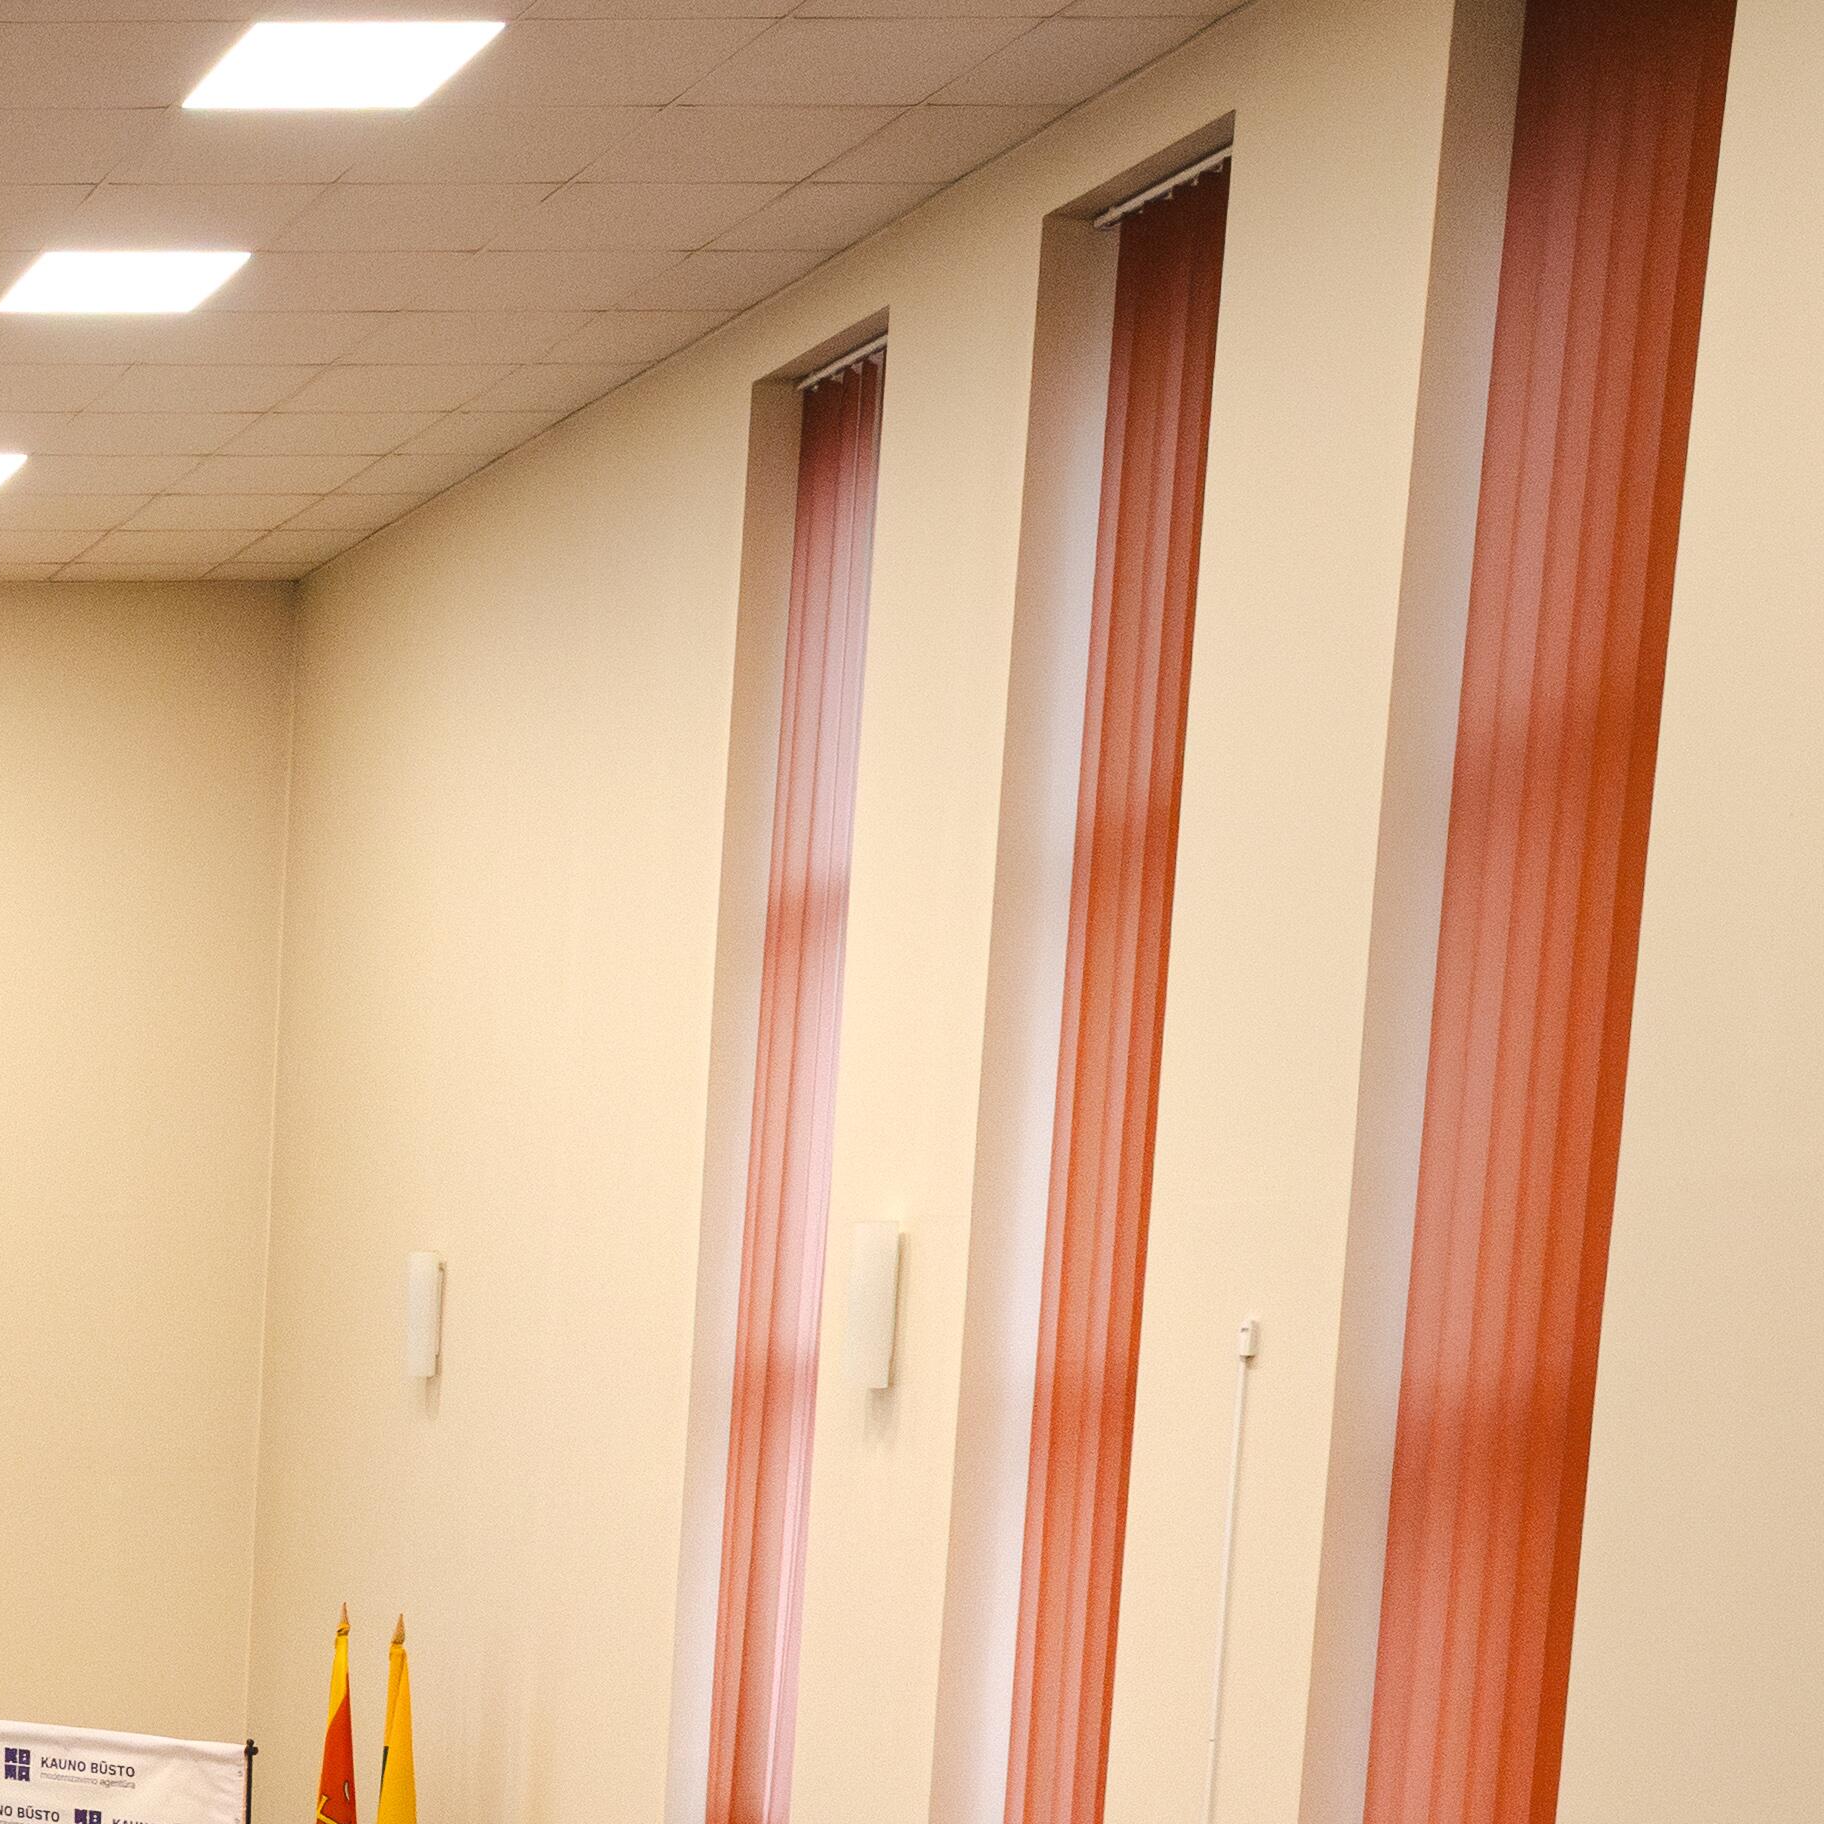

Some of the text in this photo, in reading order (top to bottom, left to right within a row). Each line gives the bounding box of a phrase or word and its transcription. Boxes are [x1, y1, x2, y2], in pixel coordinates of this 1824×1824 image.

[41, 1757, 135, 1777] KAUNO BŪSTO
[17, 1805, 60, 1822] BŪSTO
